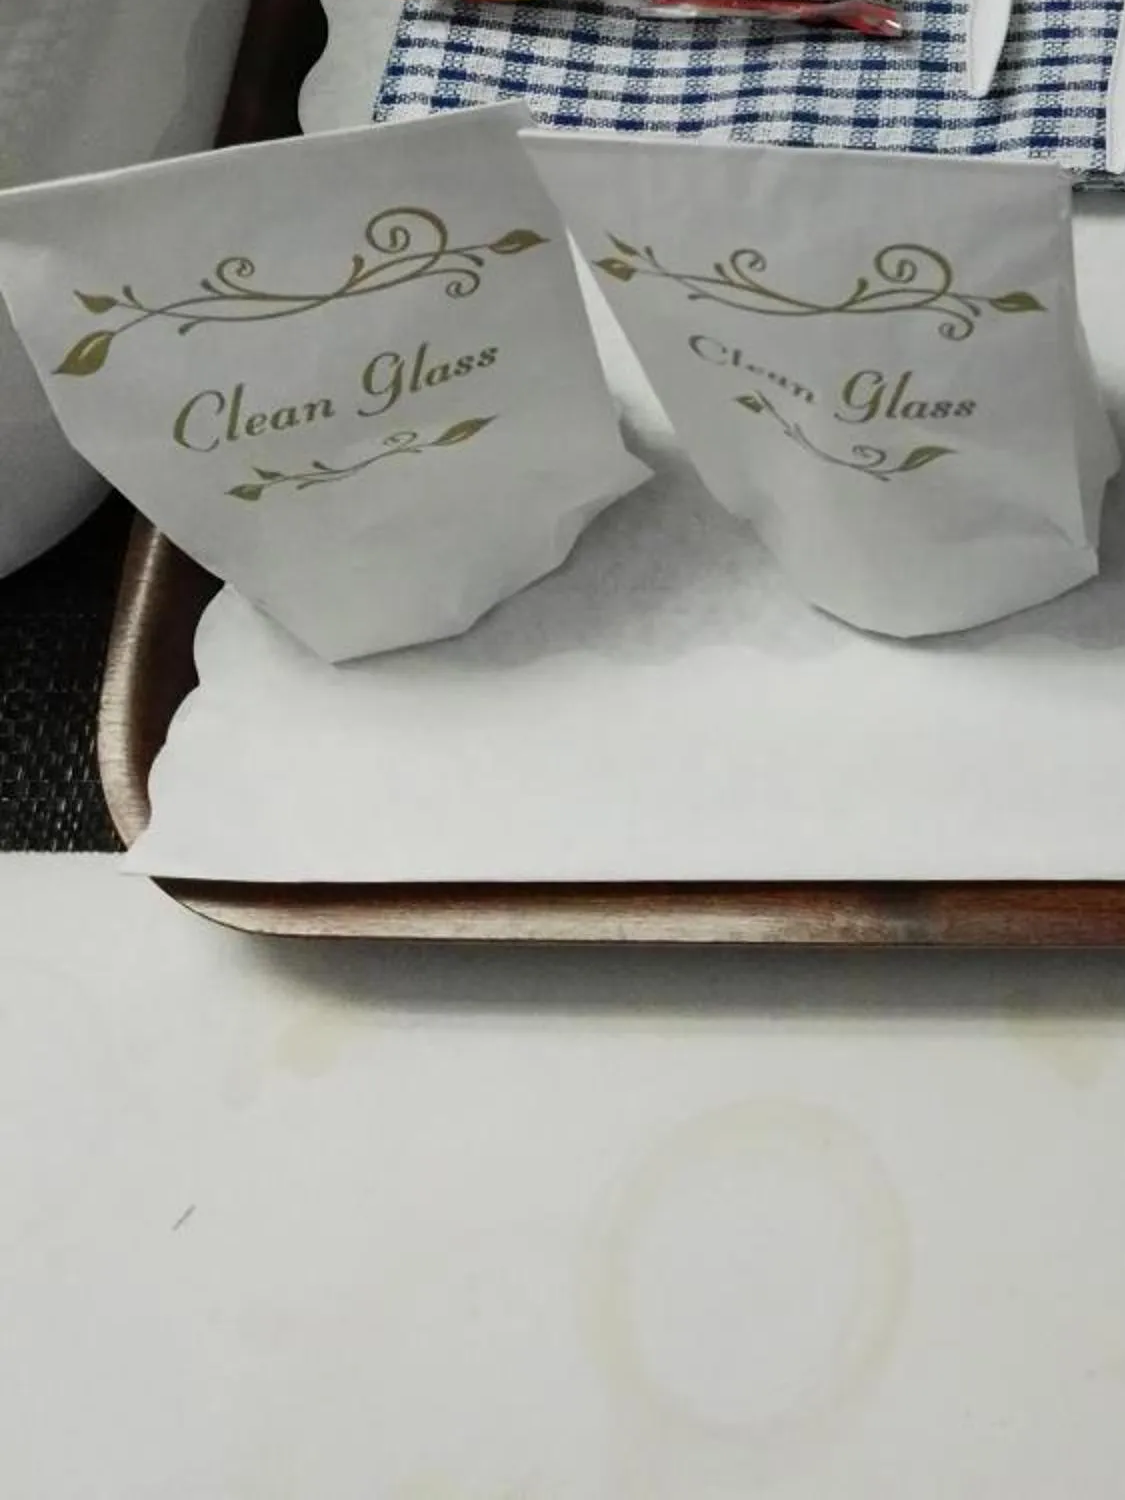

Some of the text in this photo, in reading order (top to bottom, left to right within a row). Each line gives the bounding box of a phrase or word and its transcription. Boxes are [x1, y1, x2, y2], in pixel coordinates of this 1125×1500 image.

[172, 340, 499, 453] Clean Glass
[833, 370, 978, 424] Glass
